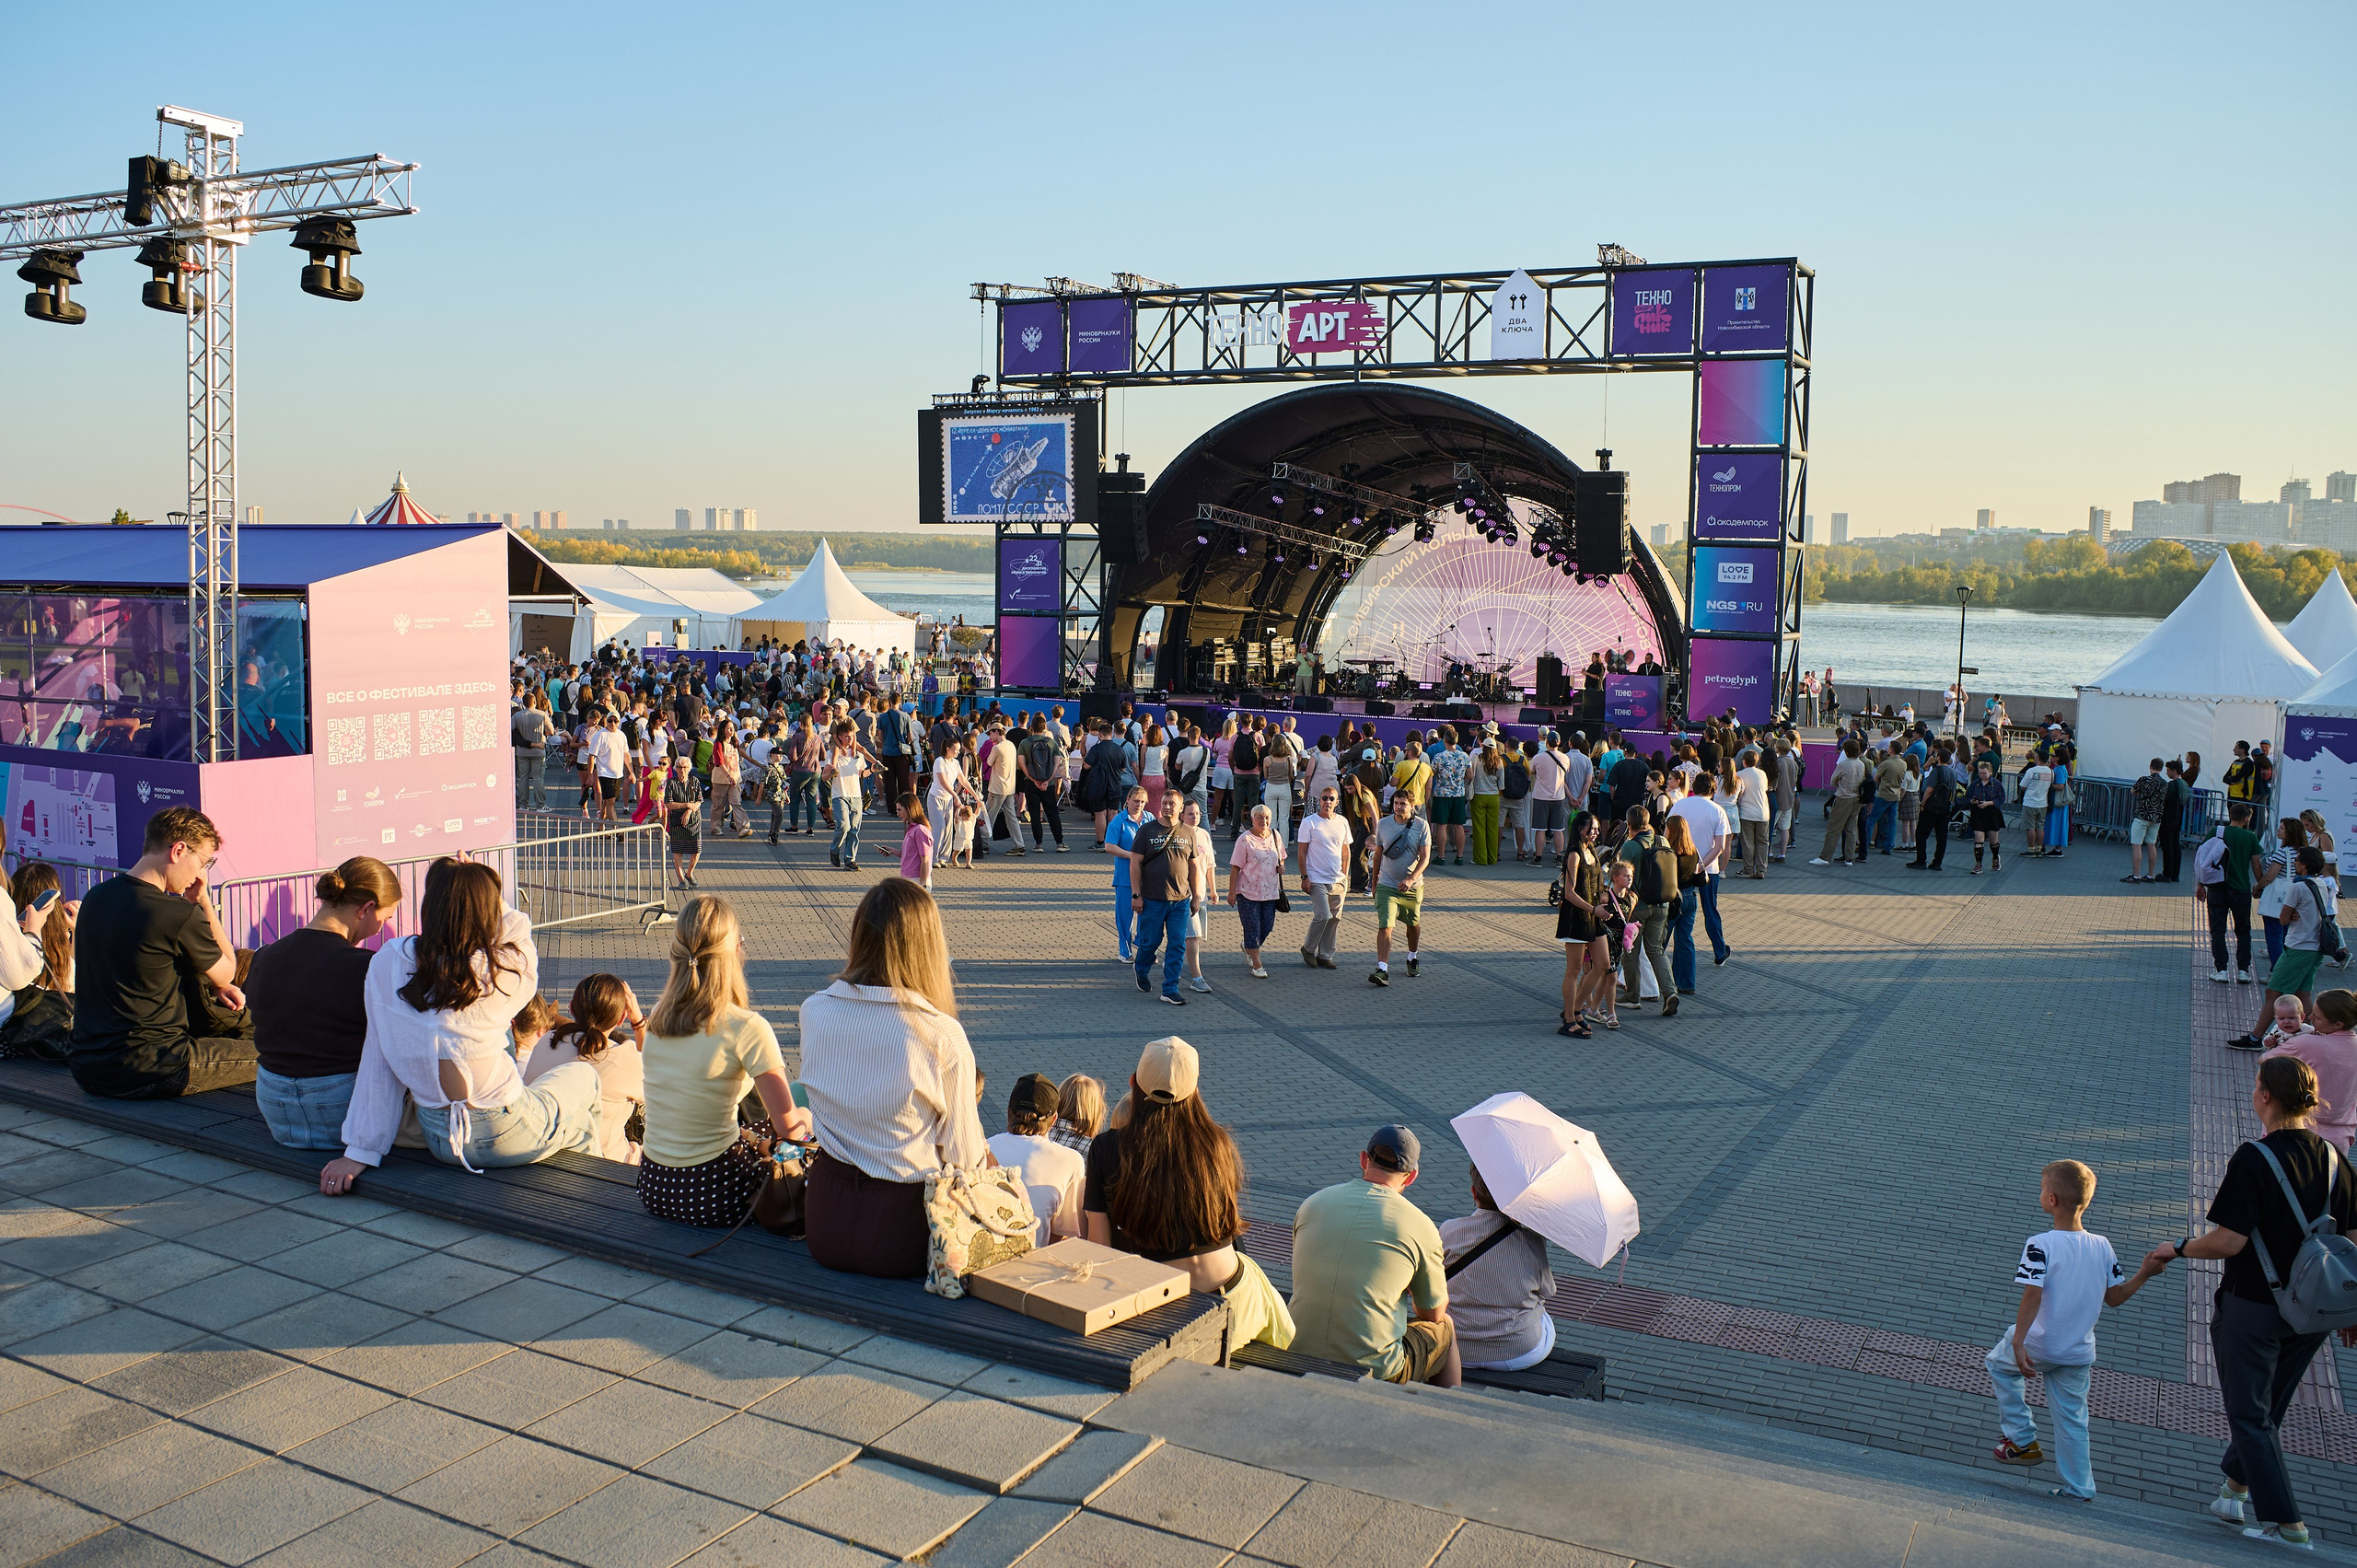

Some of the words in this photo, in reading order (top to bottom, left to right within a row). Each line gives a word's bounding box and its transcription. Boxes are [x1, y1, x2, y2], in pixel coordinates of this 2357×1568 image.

[1634, 289, 1672, 306] ТЕХНО
[1205, 311, 1283, 347] ТЕХНО
[1297, 311, 1350, 343] АРТ
[1709, 484, 1742, 493] ТЕХНОПРОМ
[1007, 503, 1039, 514] СССР
[1348, 549, 1418, 637] СИБИРСКИЙ
[1704, 674, 1758, 687] petroglyph
[326, 691, 354, 703] ВСЕ
[357, 691, 366, 702] О
[368, 684, 452, 701] ФЕСТИВАЛЕ
[454, 681, 496, 695] ЗДЕСЬ
[1614, 708, 1631, 716] ТЕХНО
[154, 786, 184, 795] МИНОБРНАУКИ
[384, 831, 394, 842] РГ
